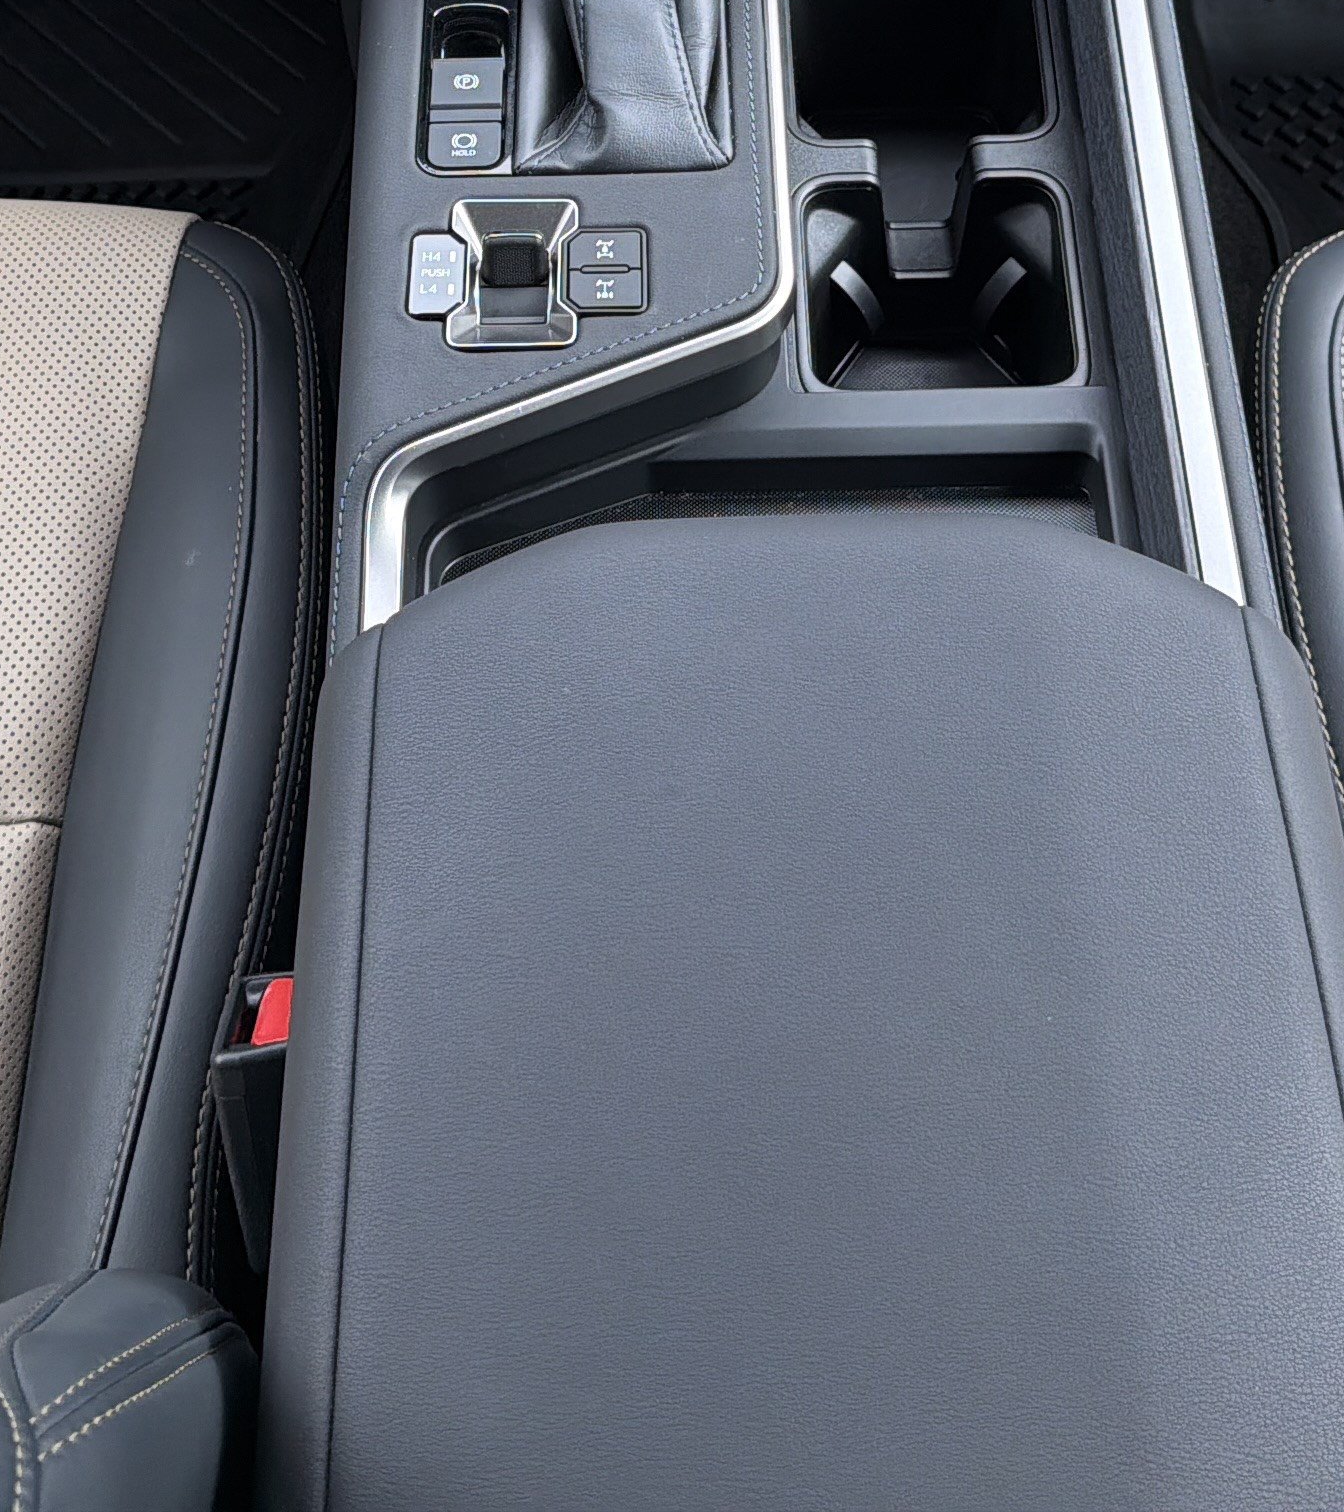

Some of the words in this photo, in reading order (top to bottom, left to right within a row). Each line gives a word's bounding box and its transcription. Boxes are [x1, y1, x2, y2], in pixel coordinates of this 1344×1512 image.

[451, 149, 477, 157] HOLD
[422, 251, 441, 262] H4
[420, 268, 451, 277] PUSH
[419, 283, 437, 295] L4
